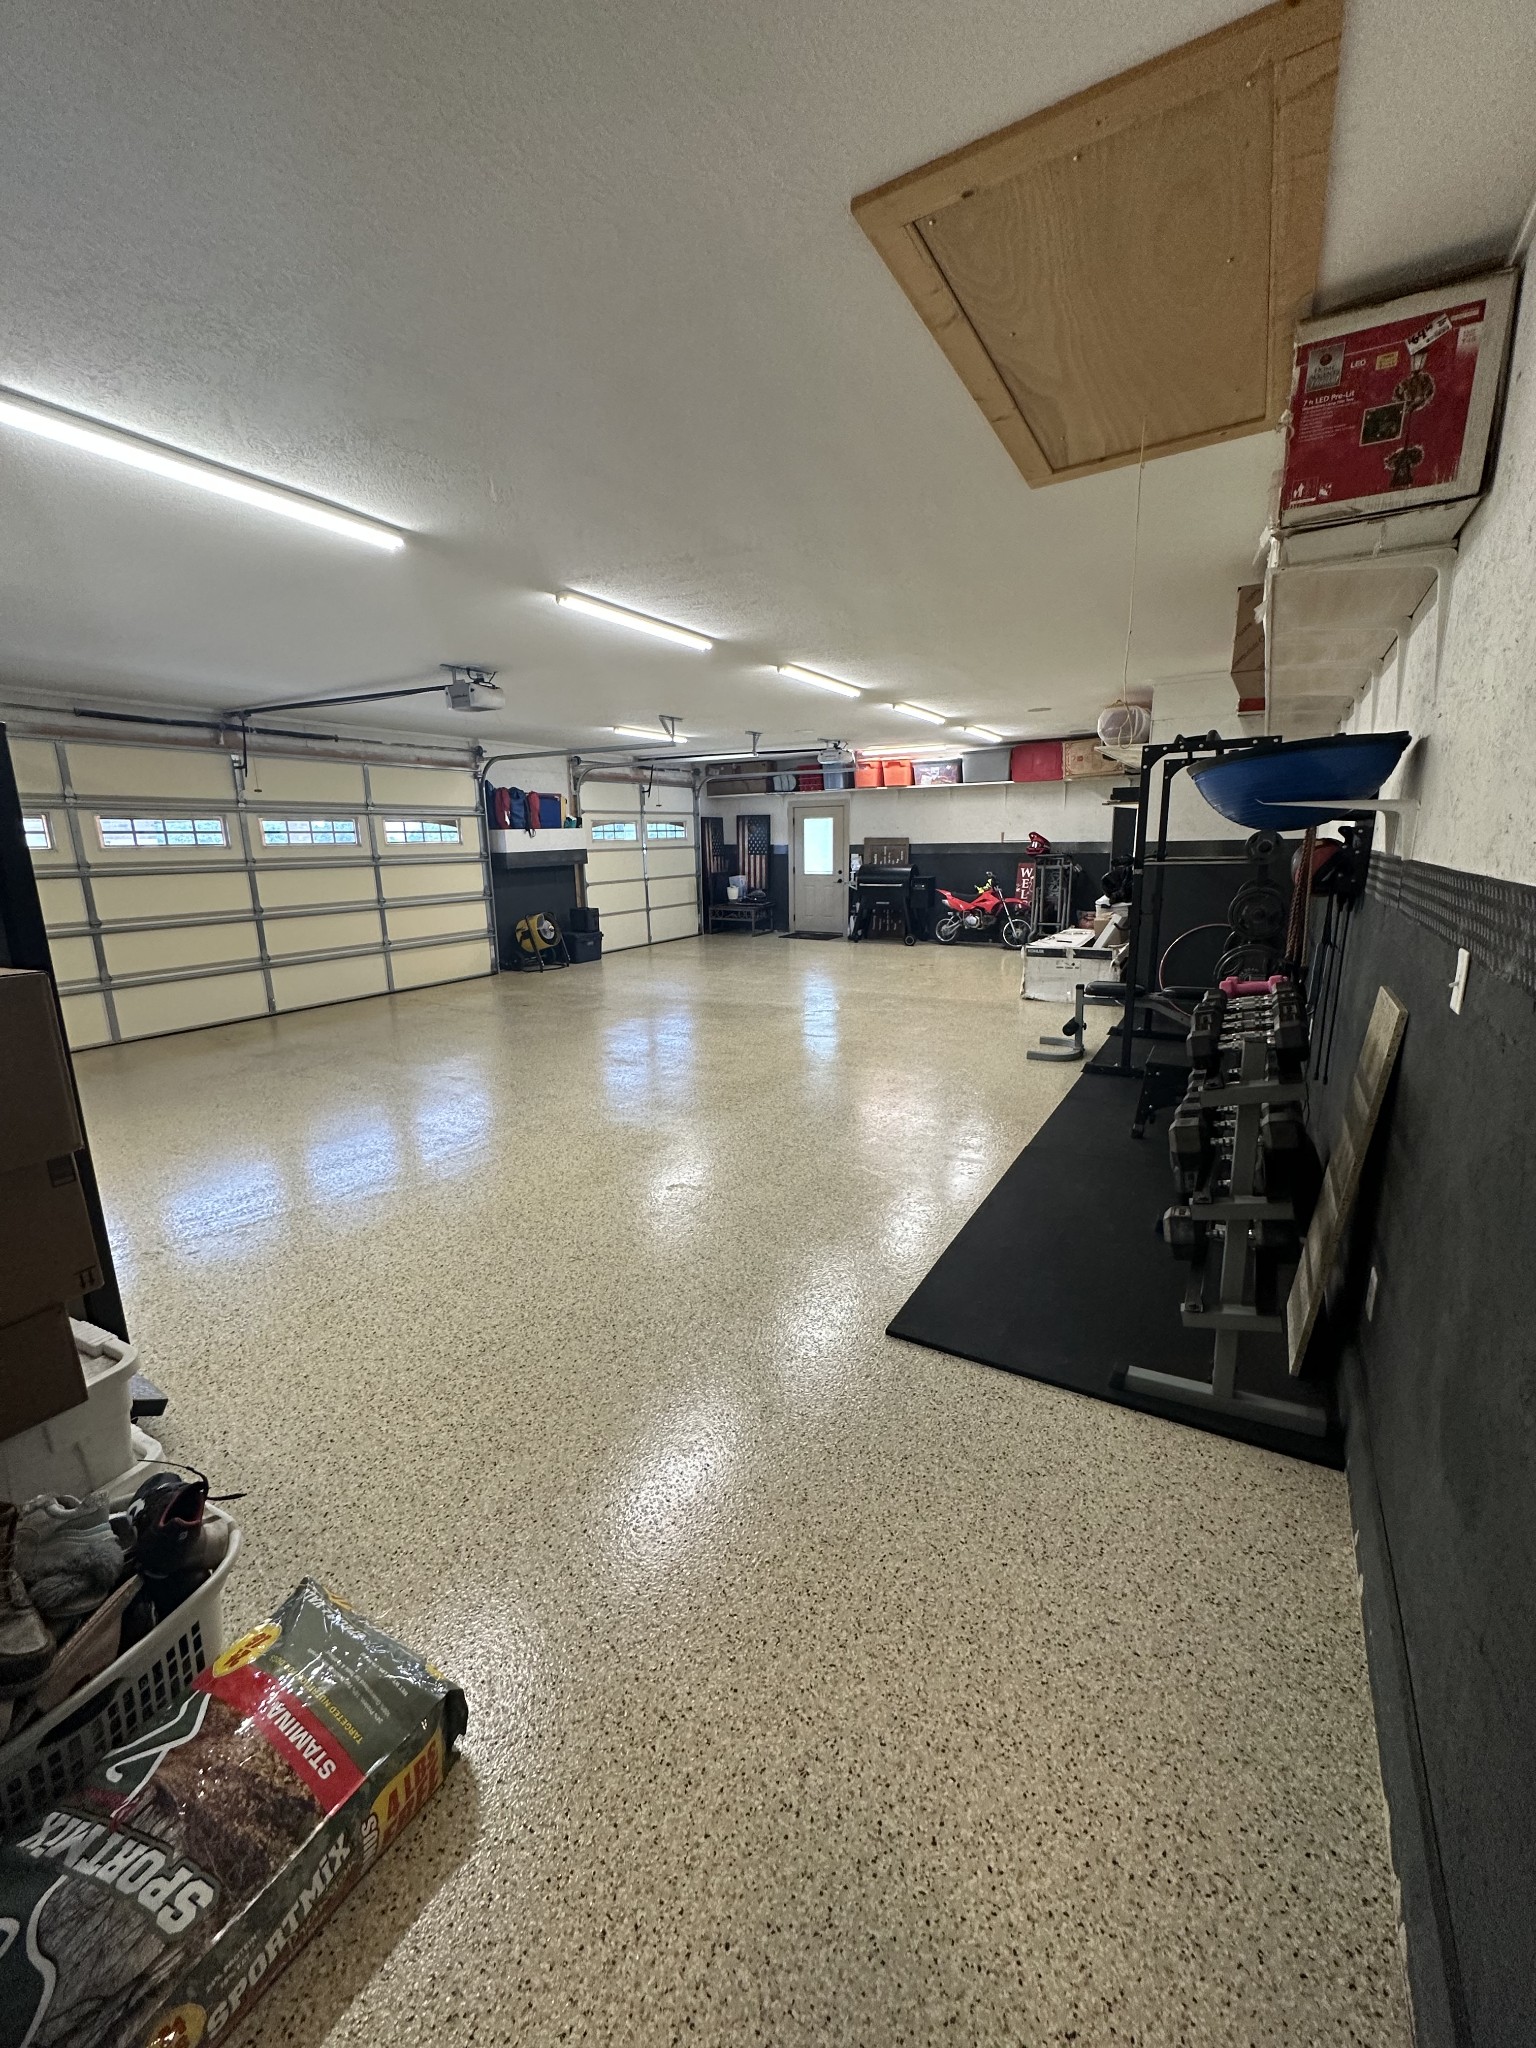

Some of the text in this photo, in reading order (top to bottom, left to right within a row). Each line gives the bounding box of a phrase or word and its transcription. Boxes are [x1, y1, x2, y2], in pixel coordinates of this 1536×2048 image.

[1350, 360, 1367, 369] LED
[1315, 395, 1330, 404] LED
[328, 1705, 364, 1744] TARGETED
[265, 1702, 337, 1780] STAMINA
